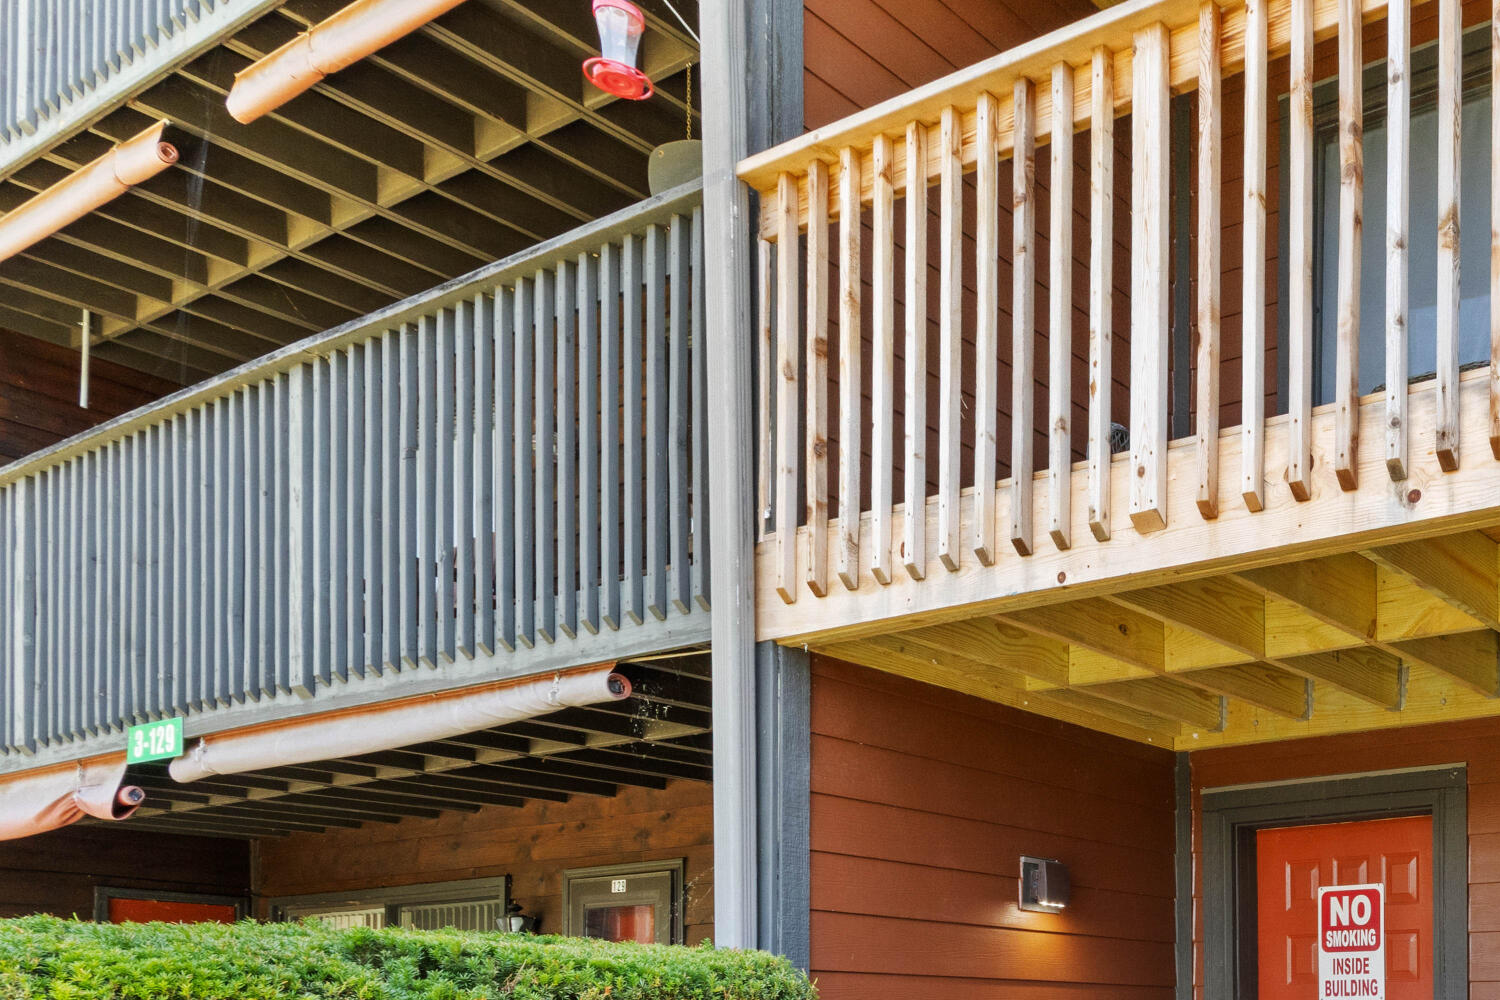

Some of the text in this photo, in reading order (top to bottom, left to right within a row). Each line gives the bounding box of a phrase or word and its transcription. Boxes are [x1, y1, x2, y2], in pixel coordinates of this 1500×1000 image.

[134, 724, 175, 758] 3-129
[1330, 894, 1372, 927] NO
[1326, 929, 1376, 948] SMOKING
[1333, 957, 1370, 975] INSIDE
[1325, 979, 1378, 997] BUILDING
